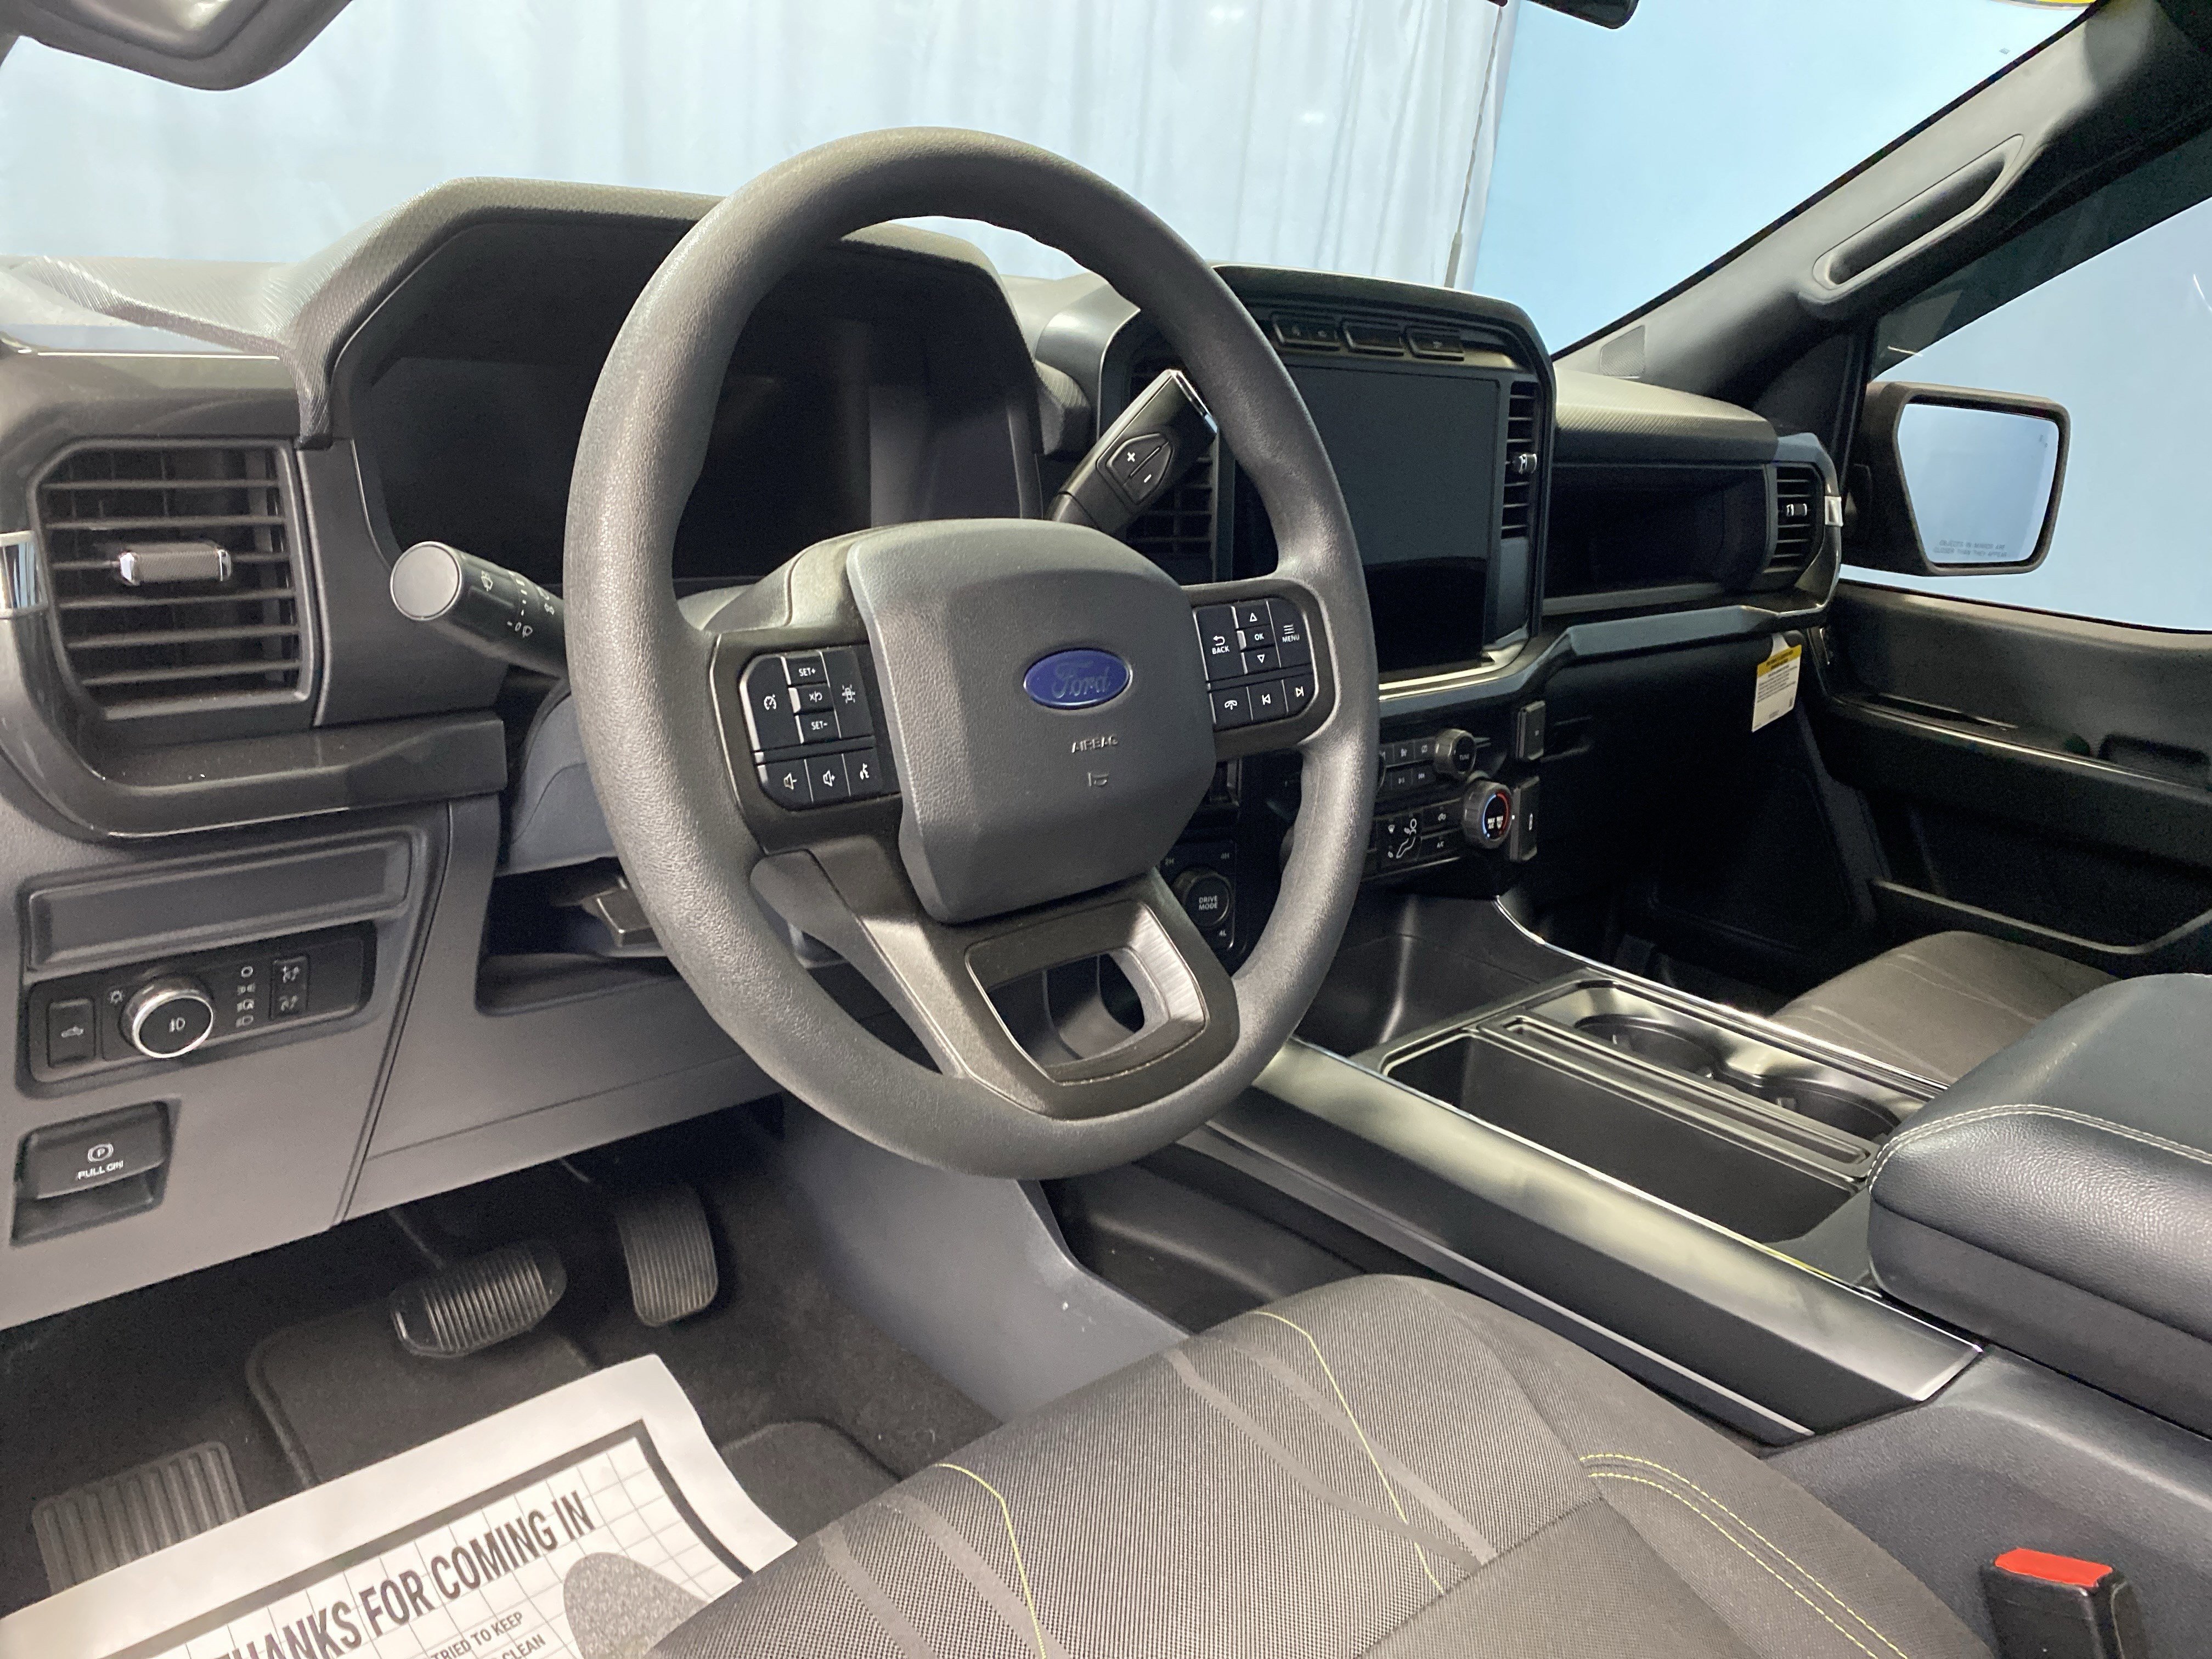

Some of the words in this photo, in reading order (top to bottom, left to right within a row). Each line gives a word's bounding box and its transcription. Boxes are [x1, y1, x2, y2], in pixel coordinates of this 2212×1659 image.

[1282, 634, 1300, 643] MENU
[1212, 646, 1230, 654] BACK
[1051, 659, 1111, 699] Ford
[1198, 902, 1218, 911] MODE
[1199, 895, 1218, 904] DRIVE
[77, 1166, 105, 1180] PULL
[106, 1160, 123, 1172] ON
[359, 1569, 435, 1638] FOR
[431, 1509, 558, 1600] COMING
[551, 1490, 596, 1541] IN
[470, 1628, 492, 1646] TO
[490, 1611, 523, 1636] KEEP
